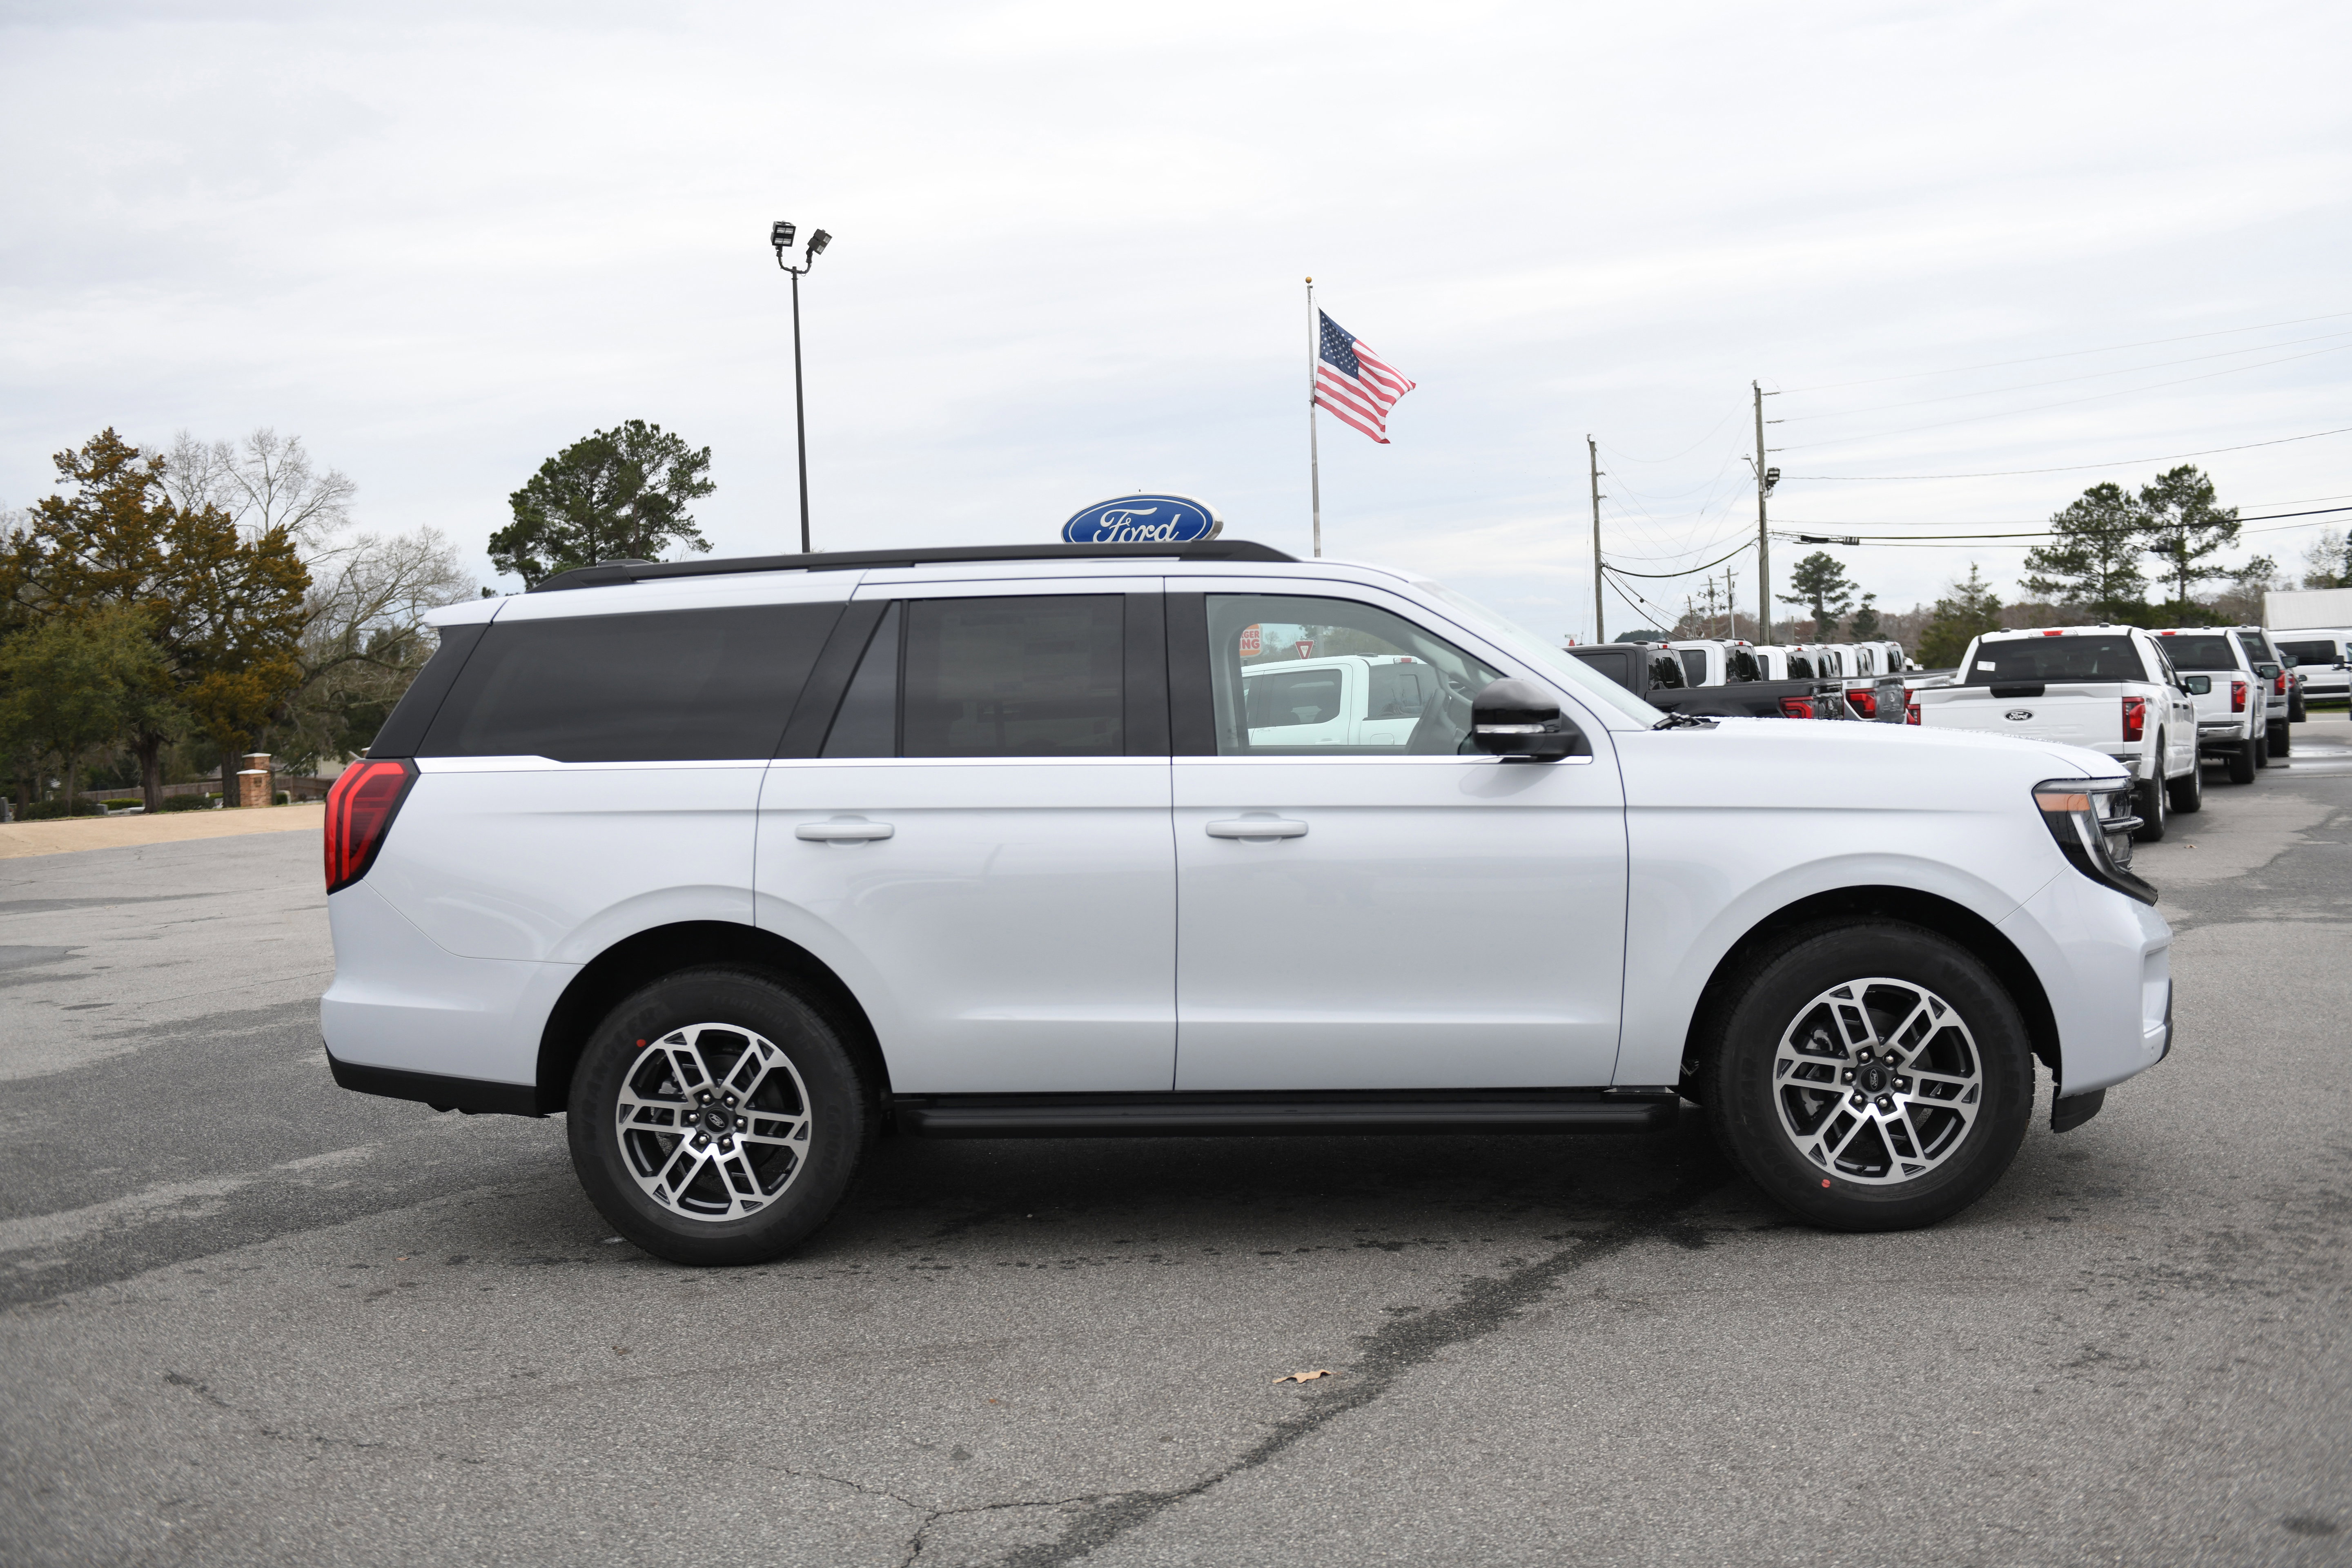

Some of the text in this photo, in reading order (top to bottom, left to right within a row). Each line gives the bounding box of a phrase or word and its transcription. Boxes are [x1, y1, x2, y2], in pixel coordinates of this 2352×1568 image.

[1093, 507, 1181, 543] Ford
[581, 1005, 659, 1143] WRANGLER
[1940, 960, 2020, 1107] WRANGLER
